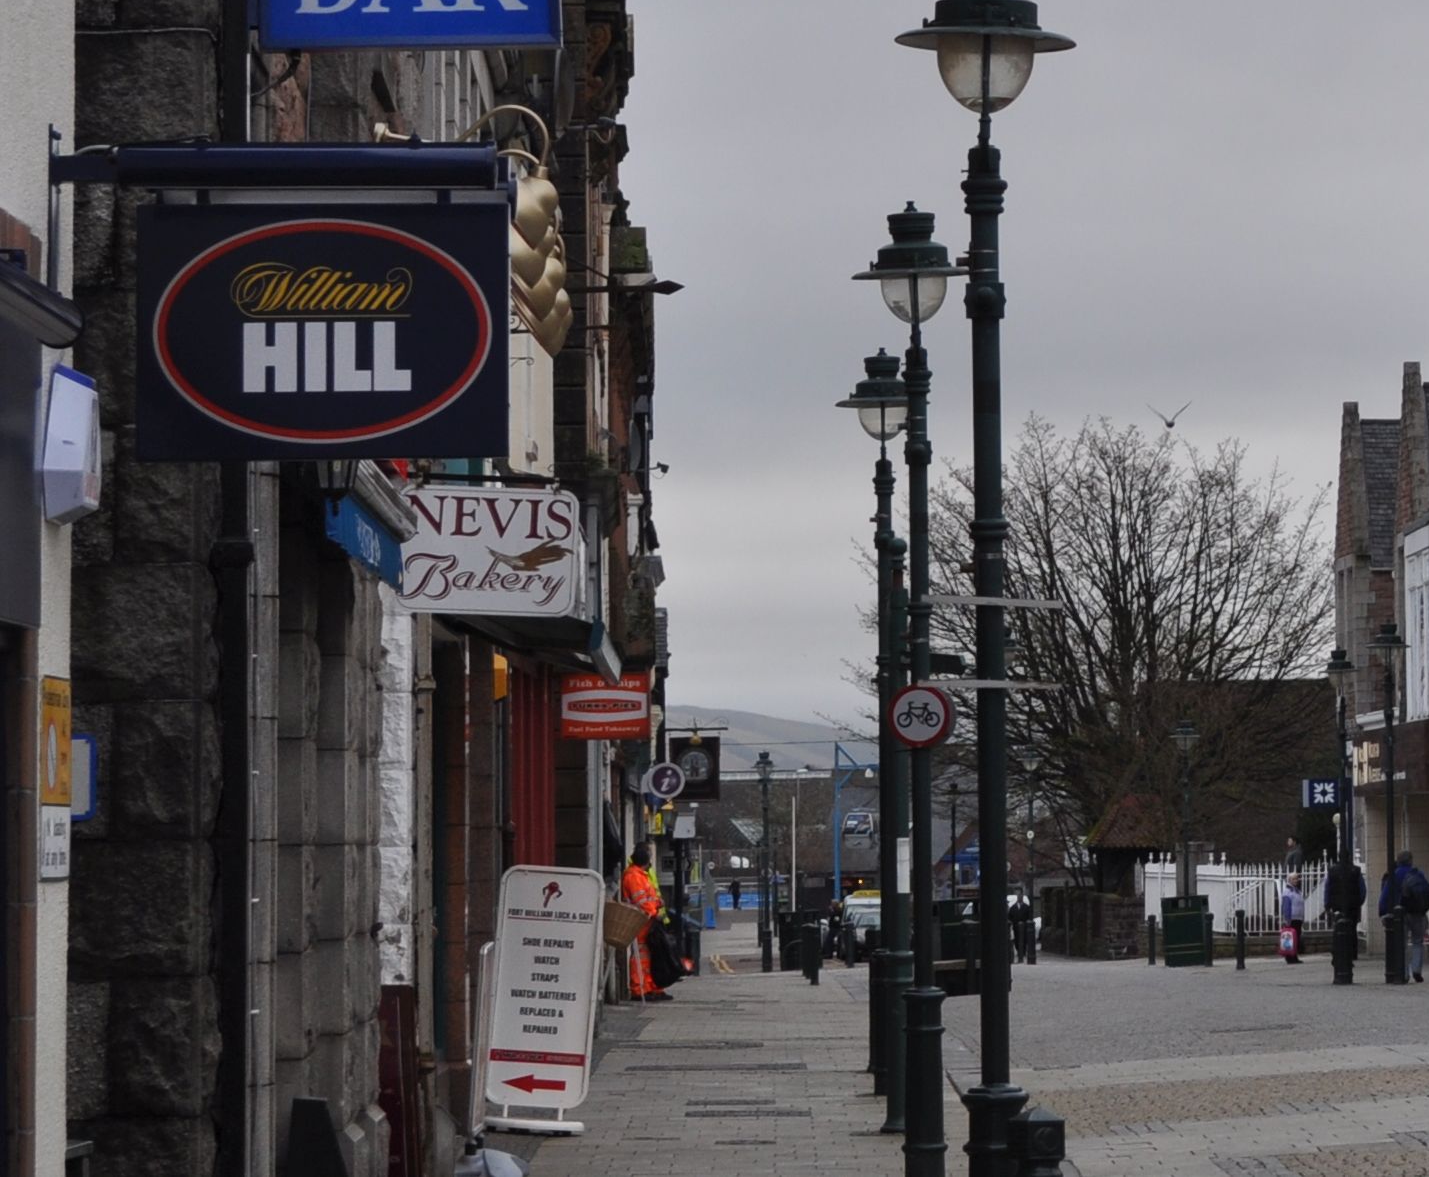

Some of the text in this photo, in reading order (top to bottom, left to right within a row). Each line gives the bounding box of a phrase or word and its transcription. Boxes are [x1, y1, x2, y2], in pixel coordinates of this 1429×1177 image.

[230, 262, 413, 315] William
[242, 321, 412, 393] HILL
[405, 493, 573, 541] NEVIS
[401, 552, 567, 607] Bakery
[508, 908, 523, 916] FORT
[524, 909, 553, 918] WILLIAM
[554, 910, 570, 919] LOCK
[578, 913, 594, 921] SAFE
[522, 937, 574, 949] SHOE REPAIRS
[534, 955, 559, 965] WATCH
[531, 972, 560, 983] STRAPS
[510, 989, 576, 1001] WATCH BATTERIES
[519, 1006, 556, 1017] REPLACED
[522, 1024, 558, 1035] REPAIRED
